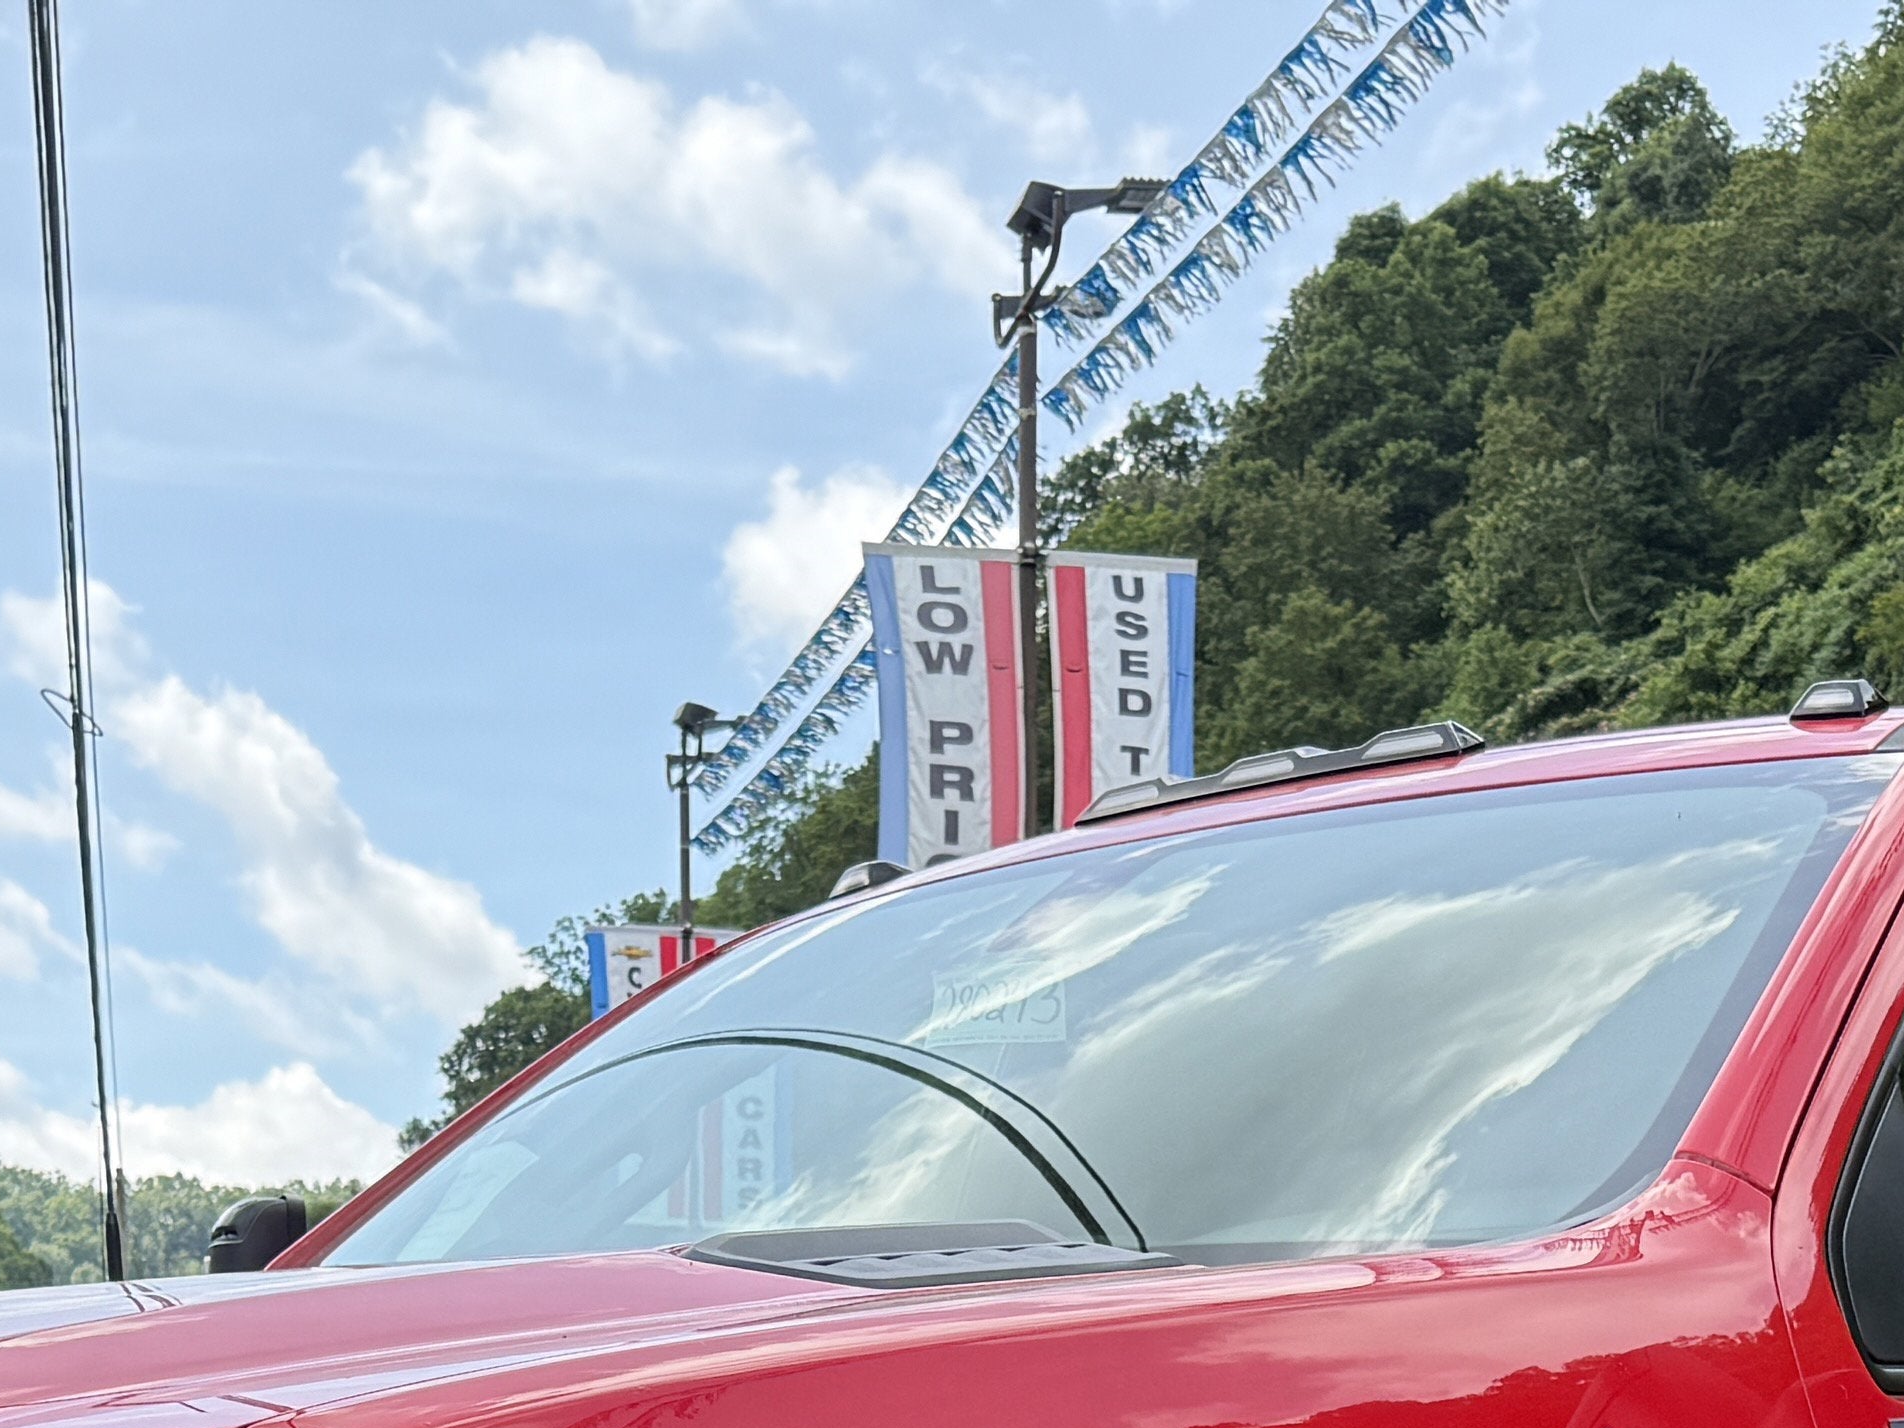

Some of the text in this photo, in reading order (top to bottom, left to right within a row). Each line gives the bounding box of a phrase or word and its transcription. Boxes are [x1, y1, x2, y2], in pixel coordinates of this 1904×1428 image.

[916, 565, 975, 866] LOW PRI
[1112, 575, 1153, 718] USED
